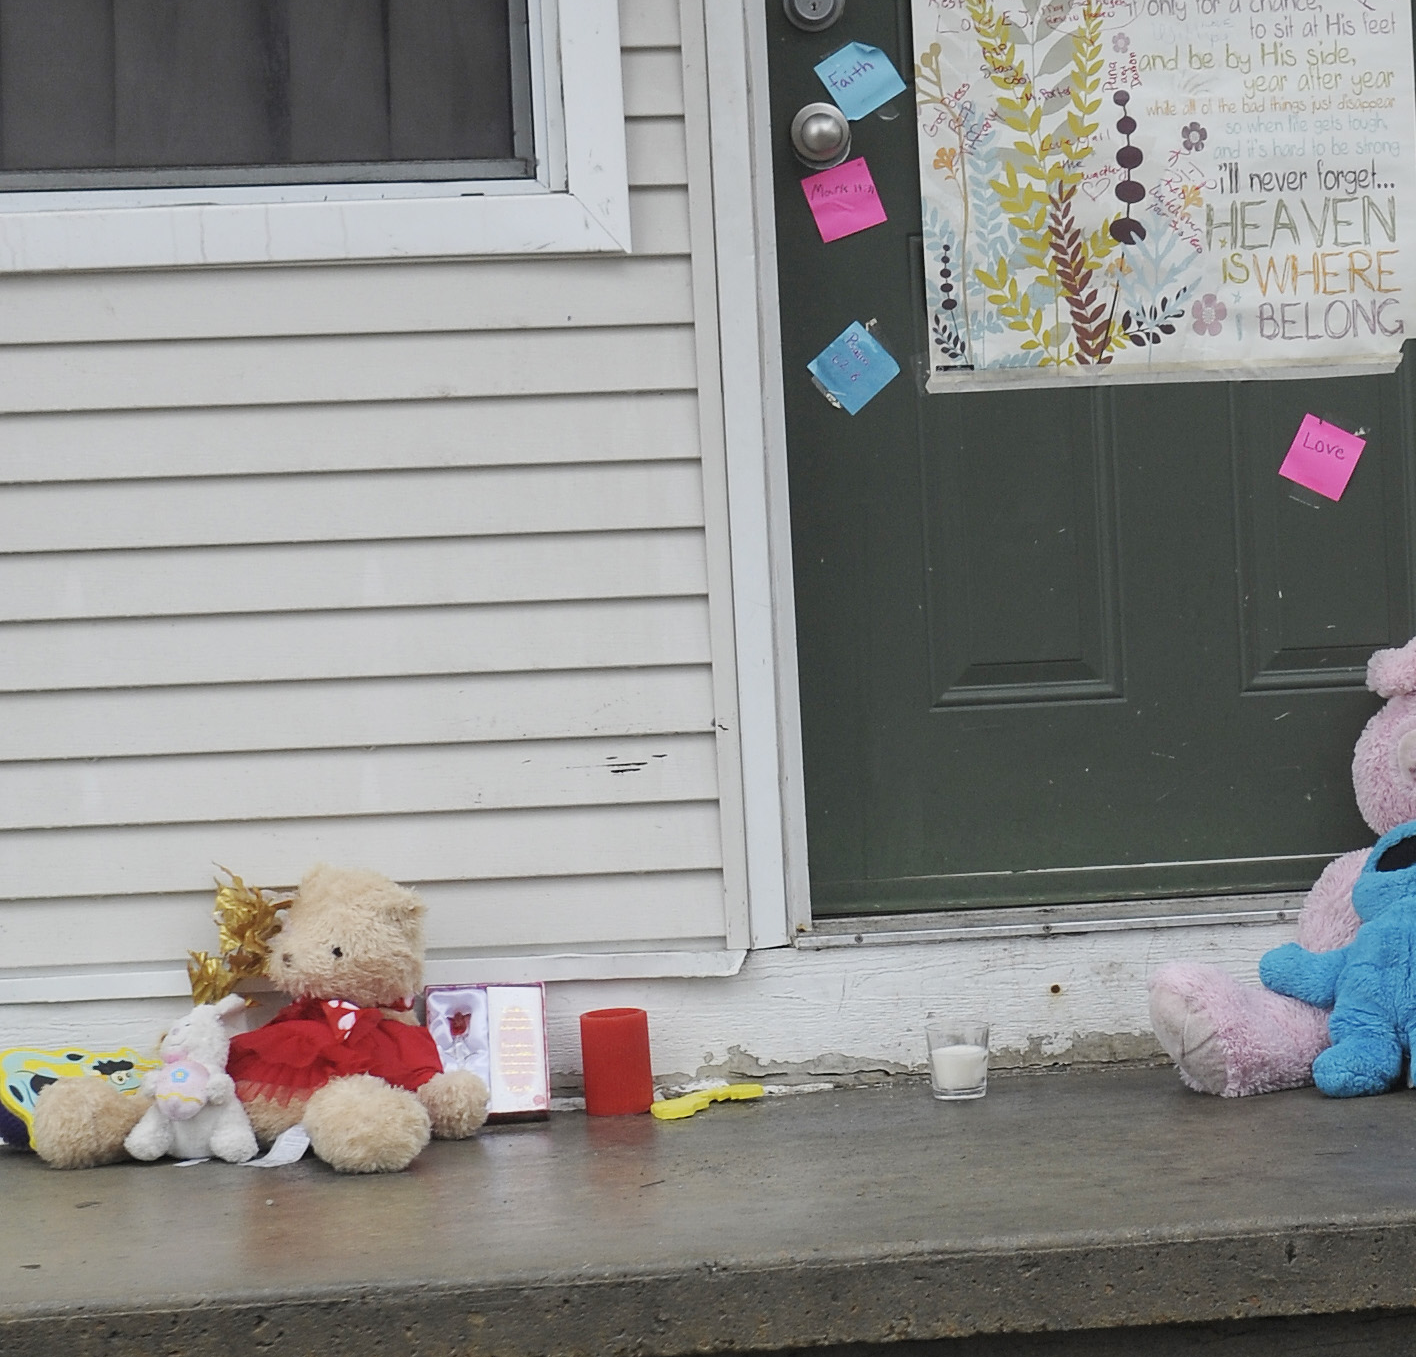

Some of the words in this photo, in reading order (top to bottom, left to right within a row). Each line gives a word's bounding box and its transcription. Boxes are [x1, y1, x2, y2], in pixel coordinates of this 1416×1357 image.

[1250, 16, 1267, 39] to
[1274, 13, 1294, 39] sit
[1302, 14, 1320, 37] at
[1326, 13, 1356, 36] His
[1362, 11, 1397, 35] feet
[1139, 43, 1179, 72] and
[1188, 43, 1216, 70] be
[1226, 42, 1252, 74] by
[1260, 41, 1297, 68] His
[1306, 40, 1357, 67] side,
[827, 60, 875, 92] Faith
[1243, 72, 1288, 99] year
[1298, 65, 1343, 92] after
[1351, 70, 1396, 96] year
[1217, 97, 1237, 115] the
[1242, 96, 1265, 115] bad
[1270, 95, 1307, 117] things
[1310, 95, 1332, 115] just
[1337, 94, 1396, 114] disappear
[1249, 169, 1308, 194] never
[1205, 194, 1397, 252] HEAVEN
[1252, 249, 1402, 297] WHERE
[1256, 297, 1405, 341] BELONG
[1302, 431, 1345, 461] Love
